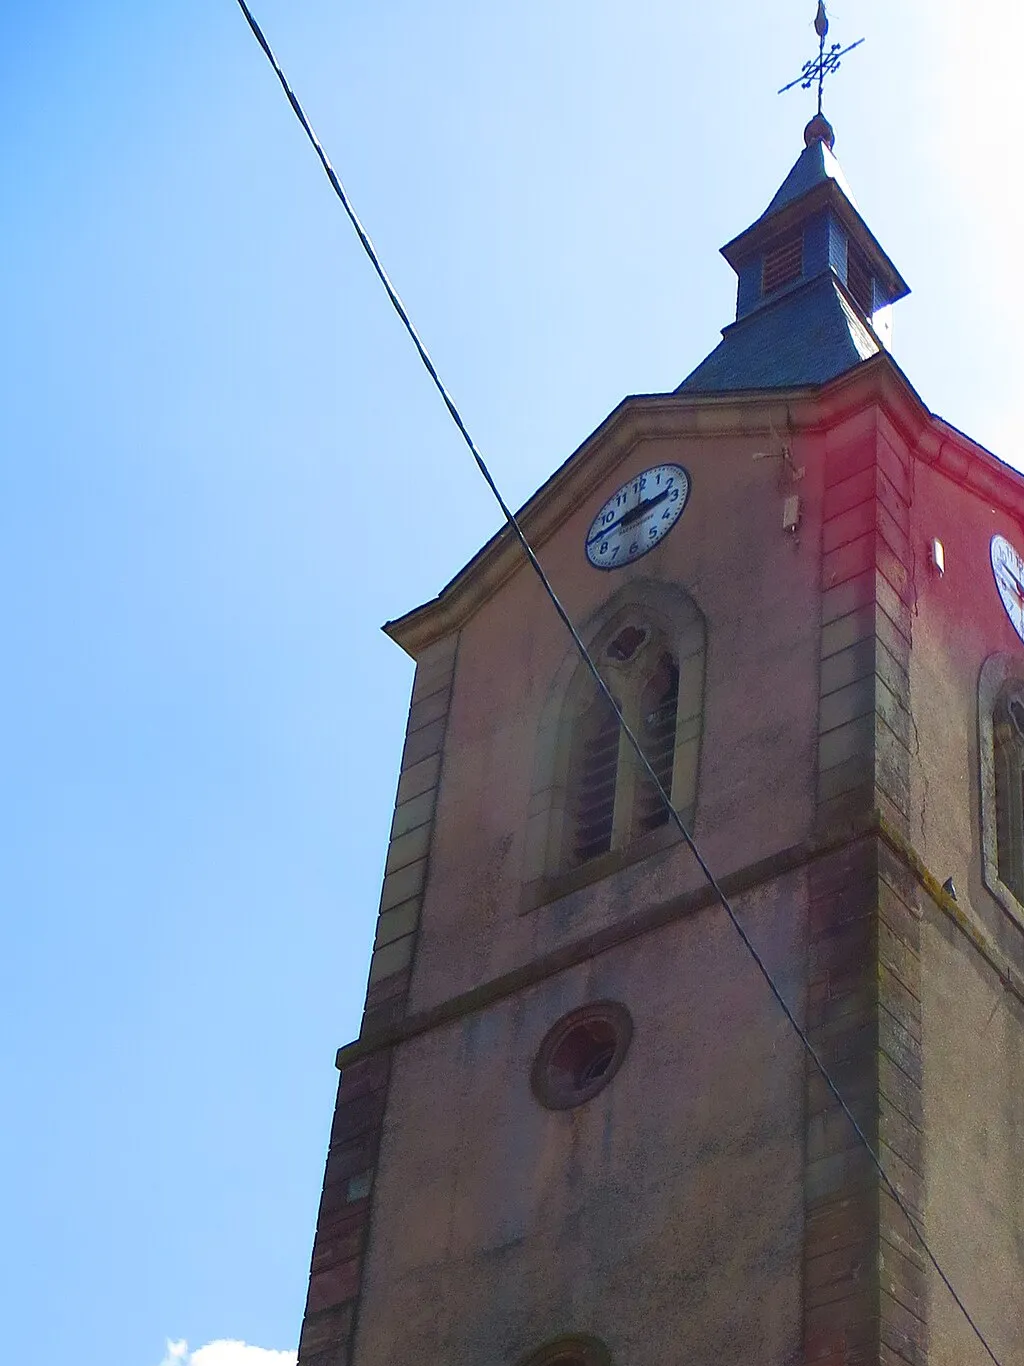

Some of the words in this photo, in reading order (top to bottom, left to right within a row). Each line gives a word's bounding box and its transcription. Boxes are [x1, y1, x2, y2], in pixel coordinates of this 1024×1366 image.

[632, 478, 647, 494] 12
[655, 474, 661, 485] 1
[665, 477, 674, 490] 2
[616, 492, 627, 507] 11
[670, 488, 679, 502] 3
[601, 510, 615, 526] 10
[661, 508, 671, 520] 4
[648, 525, 658, 539] 5
[600, 541, 609, 555] 8
[611, 545, 620, 560] 7
[629, 542, 639, 554] 6
